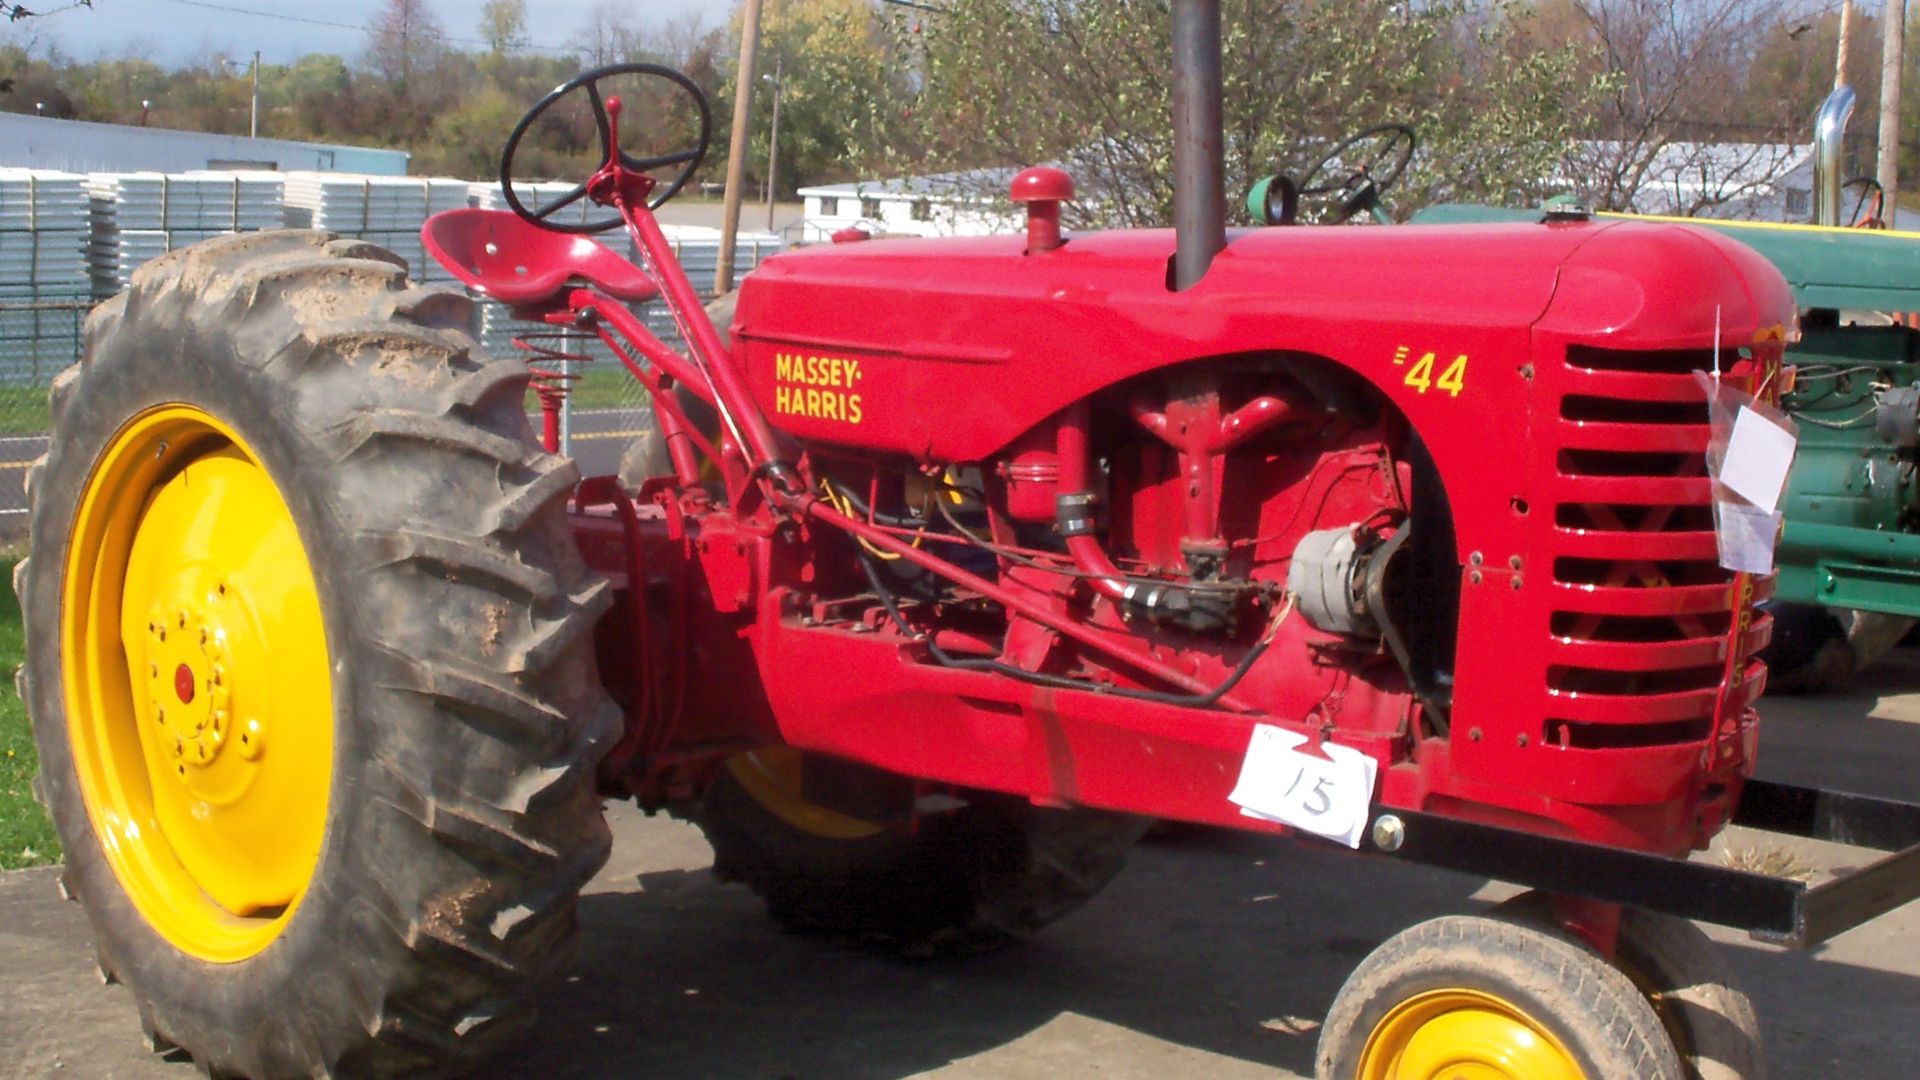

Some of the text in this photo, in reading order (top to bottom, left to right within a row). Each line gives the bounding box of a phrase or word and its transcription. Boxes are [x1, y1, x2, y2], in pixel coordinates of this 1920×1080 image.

[1404, 352, 1468, 397] 44
[776, 386, 861, 424] HARRIS
[1732, 584, 1754, 689] RRIS
[1284, 766, 1336, 817] 15
